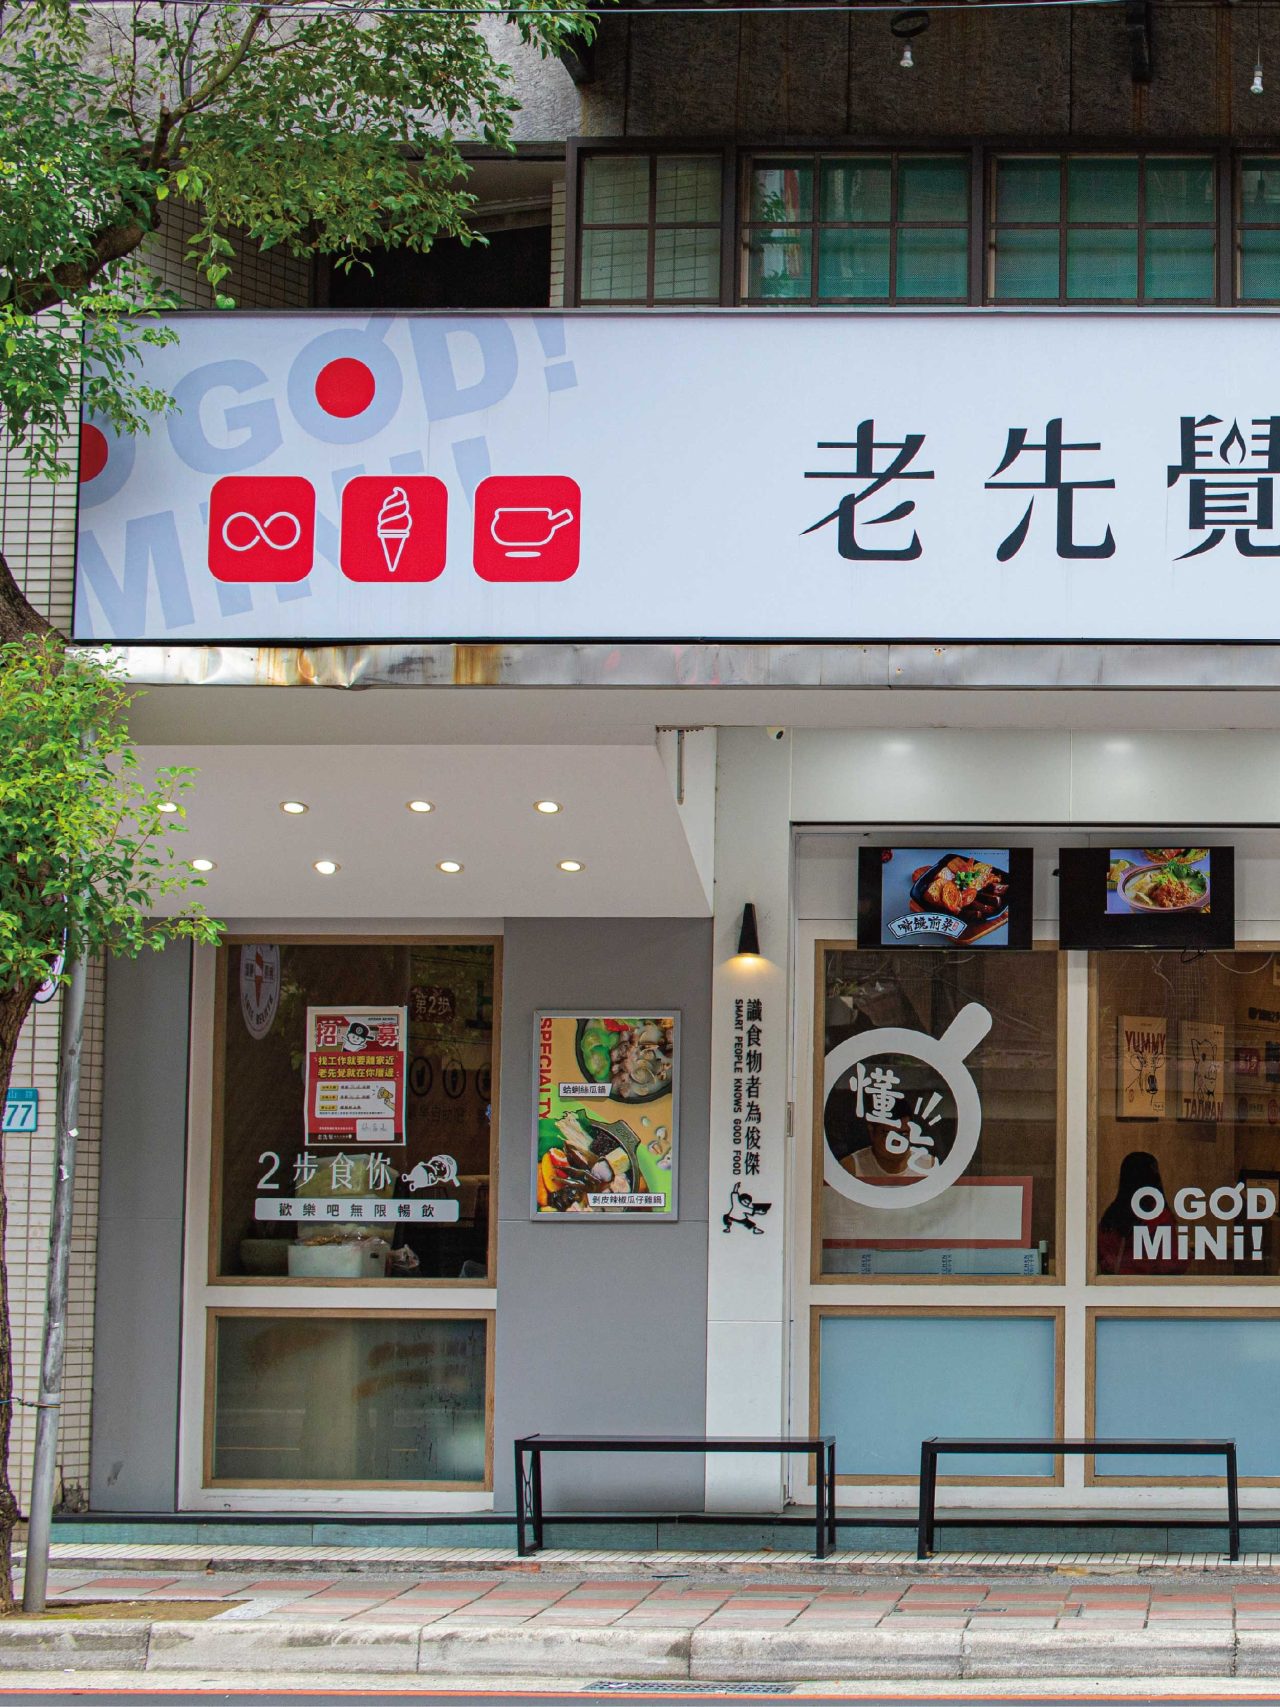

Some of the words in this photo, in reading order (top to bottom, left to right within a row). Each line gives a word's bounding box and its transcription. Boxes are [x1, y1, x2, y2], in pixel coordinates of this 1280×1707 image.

[734, 998, 744, 1031] SMART
[734, 1036, 743, 1073] PEOPLE
[1125, 1031, 1166, 1053] YUMMY
[733, 1078, 743, 1113] KNOWS
[6, 1104, 33, 1126] 77
[733, 1119, 742, 1145] GOOD
[256, 1151, 392, 1190] 2步食你
[733, 1150, 741, 1175] FOOD
[279, 1203, 434, 1218] 歡樂吧無限暢飲
